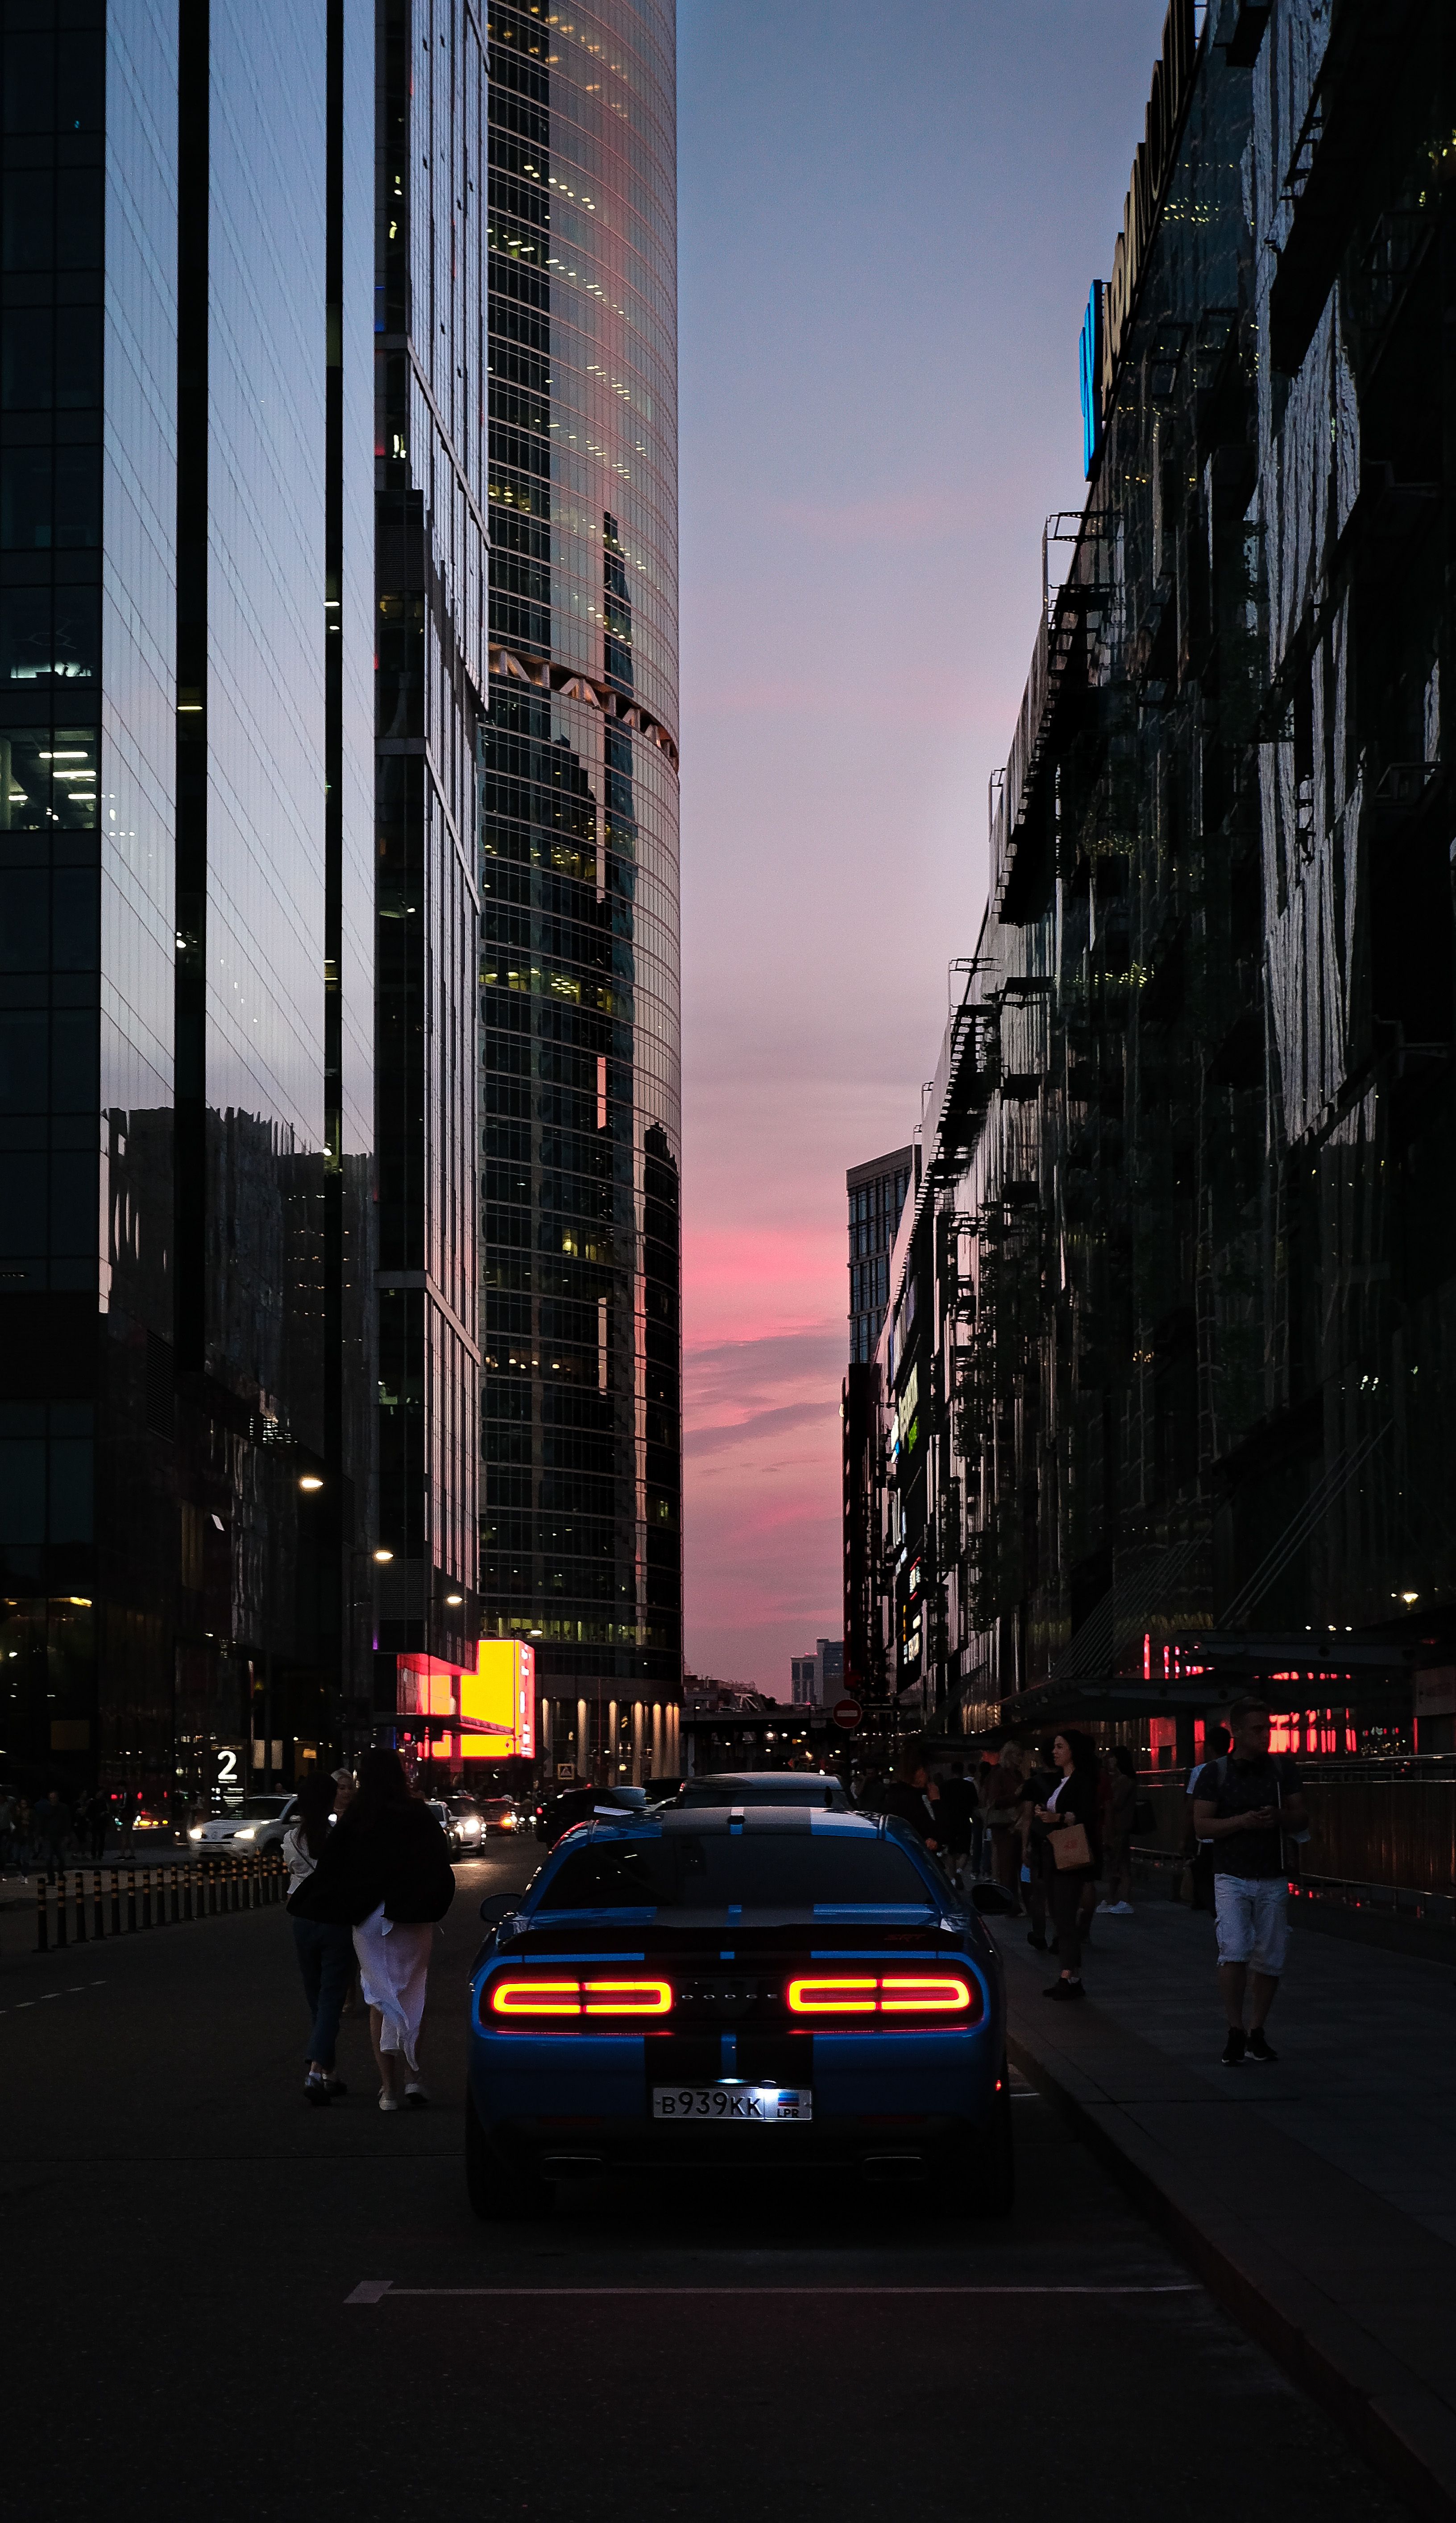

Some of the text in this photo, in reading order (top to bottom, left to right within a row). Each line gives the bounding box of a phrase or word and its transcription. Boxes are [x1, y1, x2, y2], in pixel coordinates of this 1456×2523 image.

[217, 1750, 237, 1780] 2
[662, 2091, 762, 2116] B939KK
[776, 2108, 800, 2118] LPR
